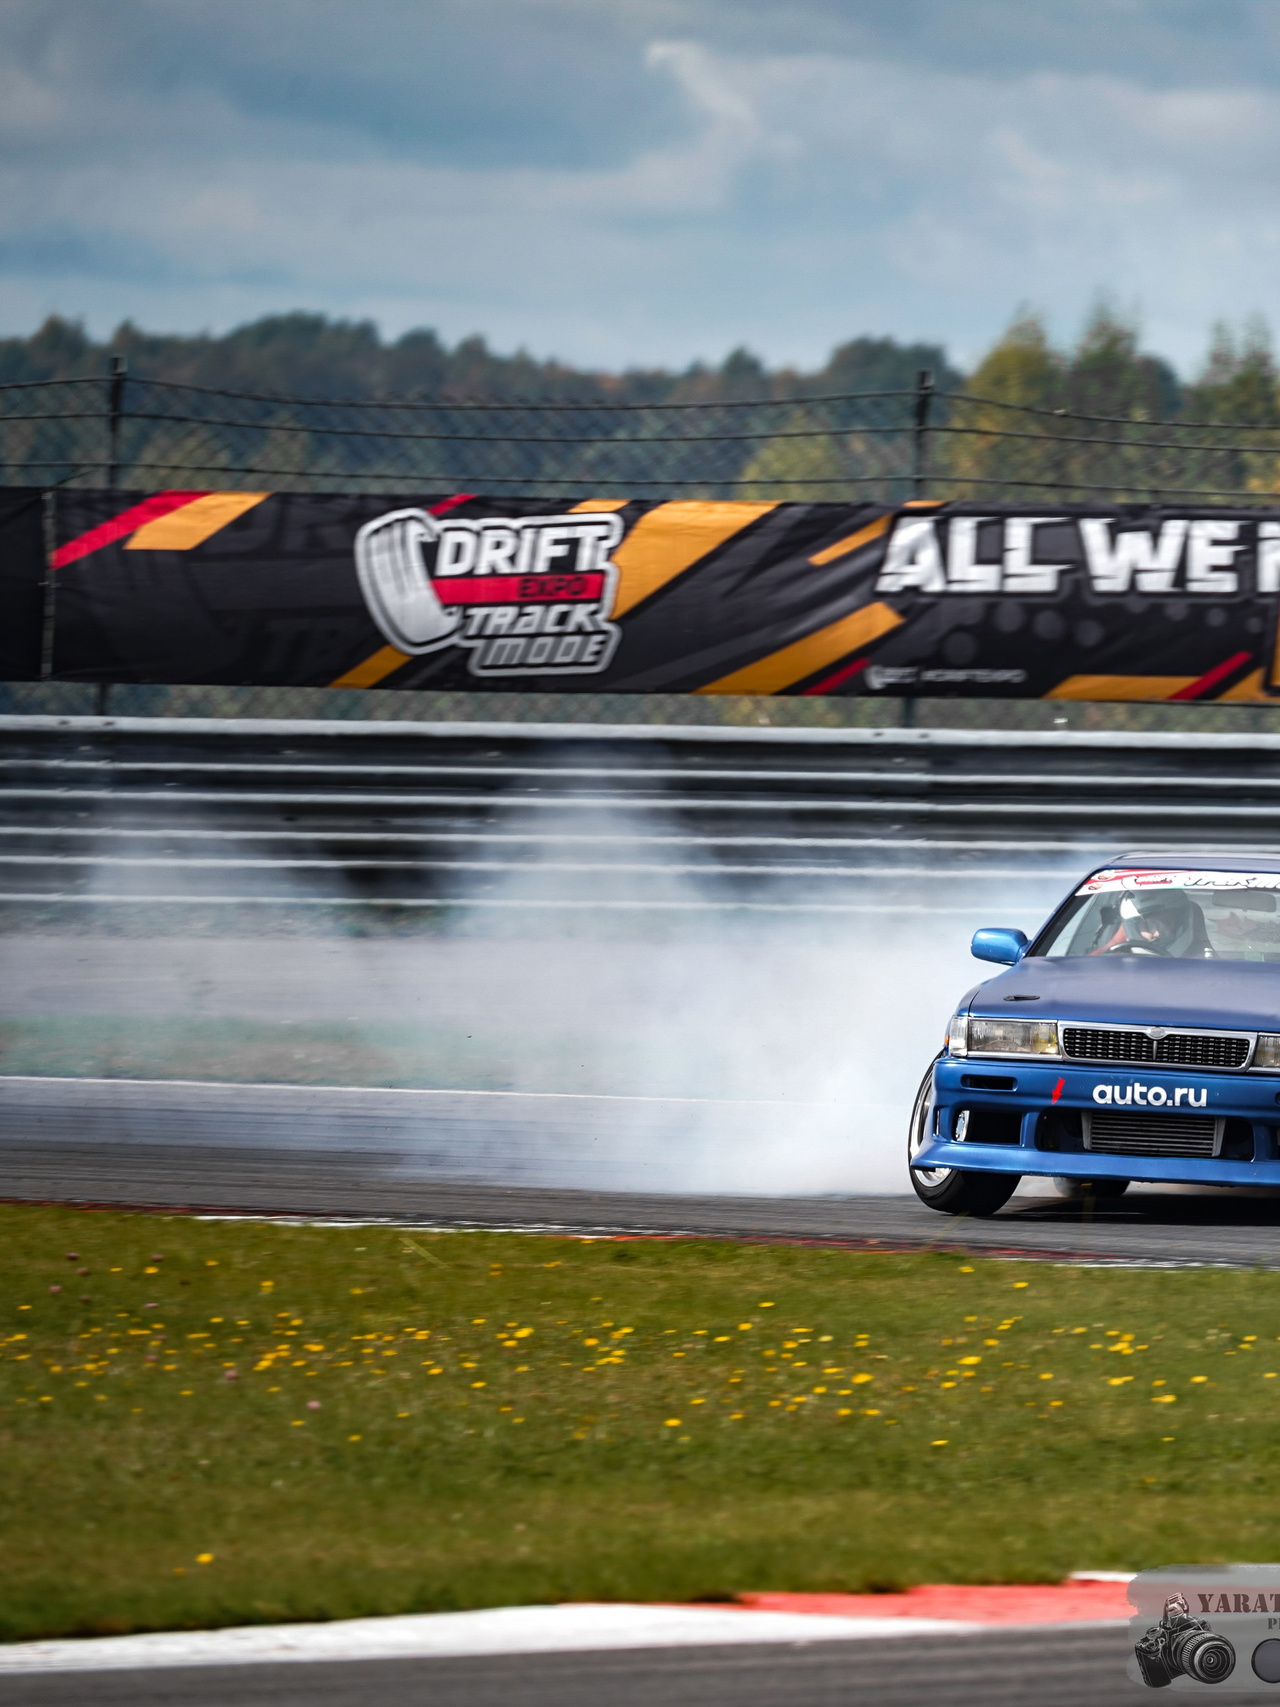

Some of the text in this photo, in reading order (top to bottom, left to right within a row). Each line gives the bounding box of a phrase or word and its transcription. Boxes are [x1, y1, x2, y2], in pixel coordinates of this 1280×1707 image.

[434, 524, 608, 577] DRIFT
[874, 516, 1076, 592] ALL
[1078, 517, 1252, 592] WE
[519, 578, 586, 597] EXPO
[483, 637, 609, 665] MODE
[1092, 1082, 1207, 1107] auto.ru
